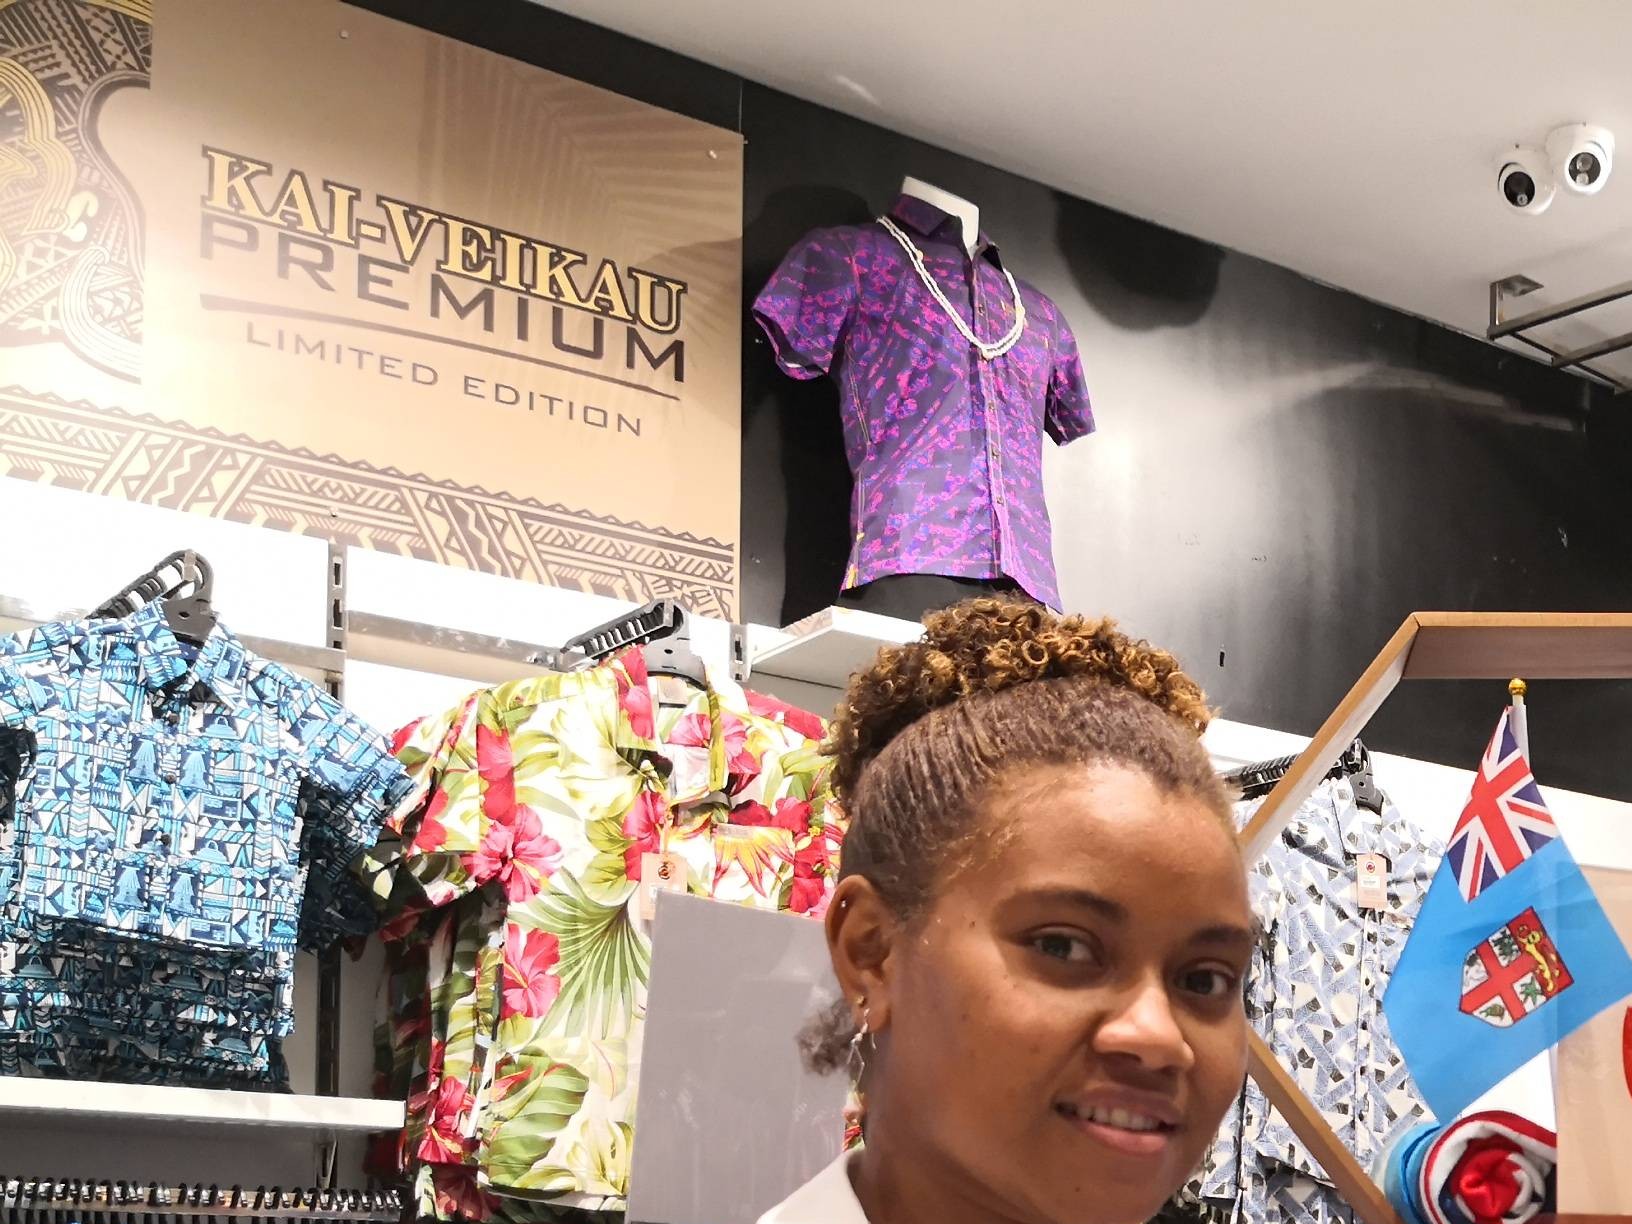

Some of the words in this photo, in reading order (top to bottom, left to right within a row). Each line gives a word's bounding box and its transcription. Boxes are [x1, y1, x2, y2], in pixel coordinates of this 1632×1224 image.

[200, 210, 685, 383] PREMIUM
[201, 145, 688, 334] KAI-VEIKAU
[247, 322, 439, 387] LIMITED
[464, 375, 641, 437] EDITION
